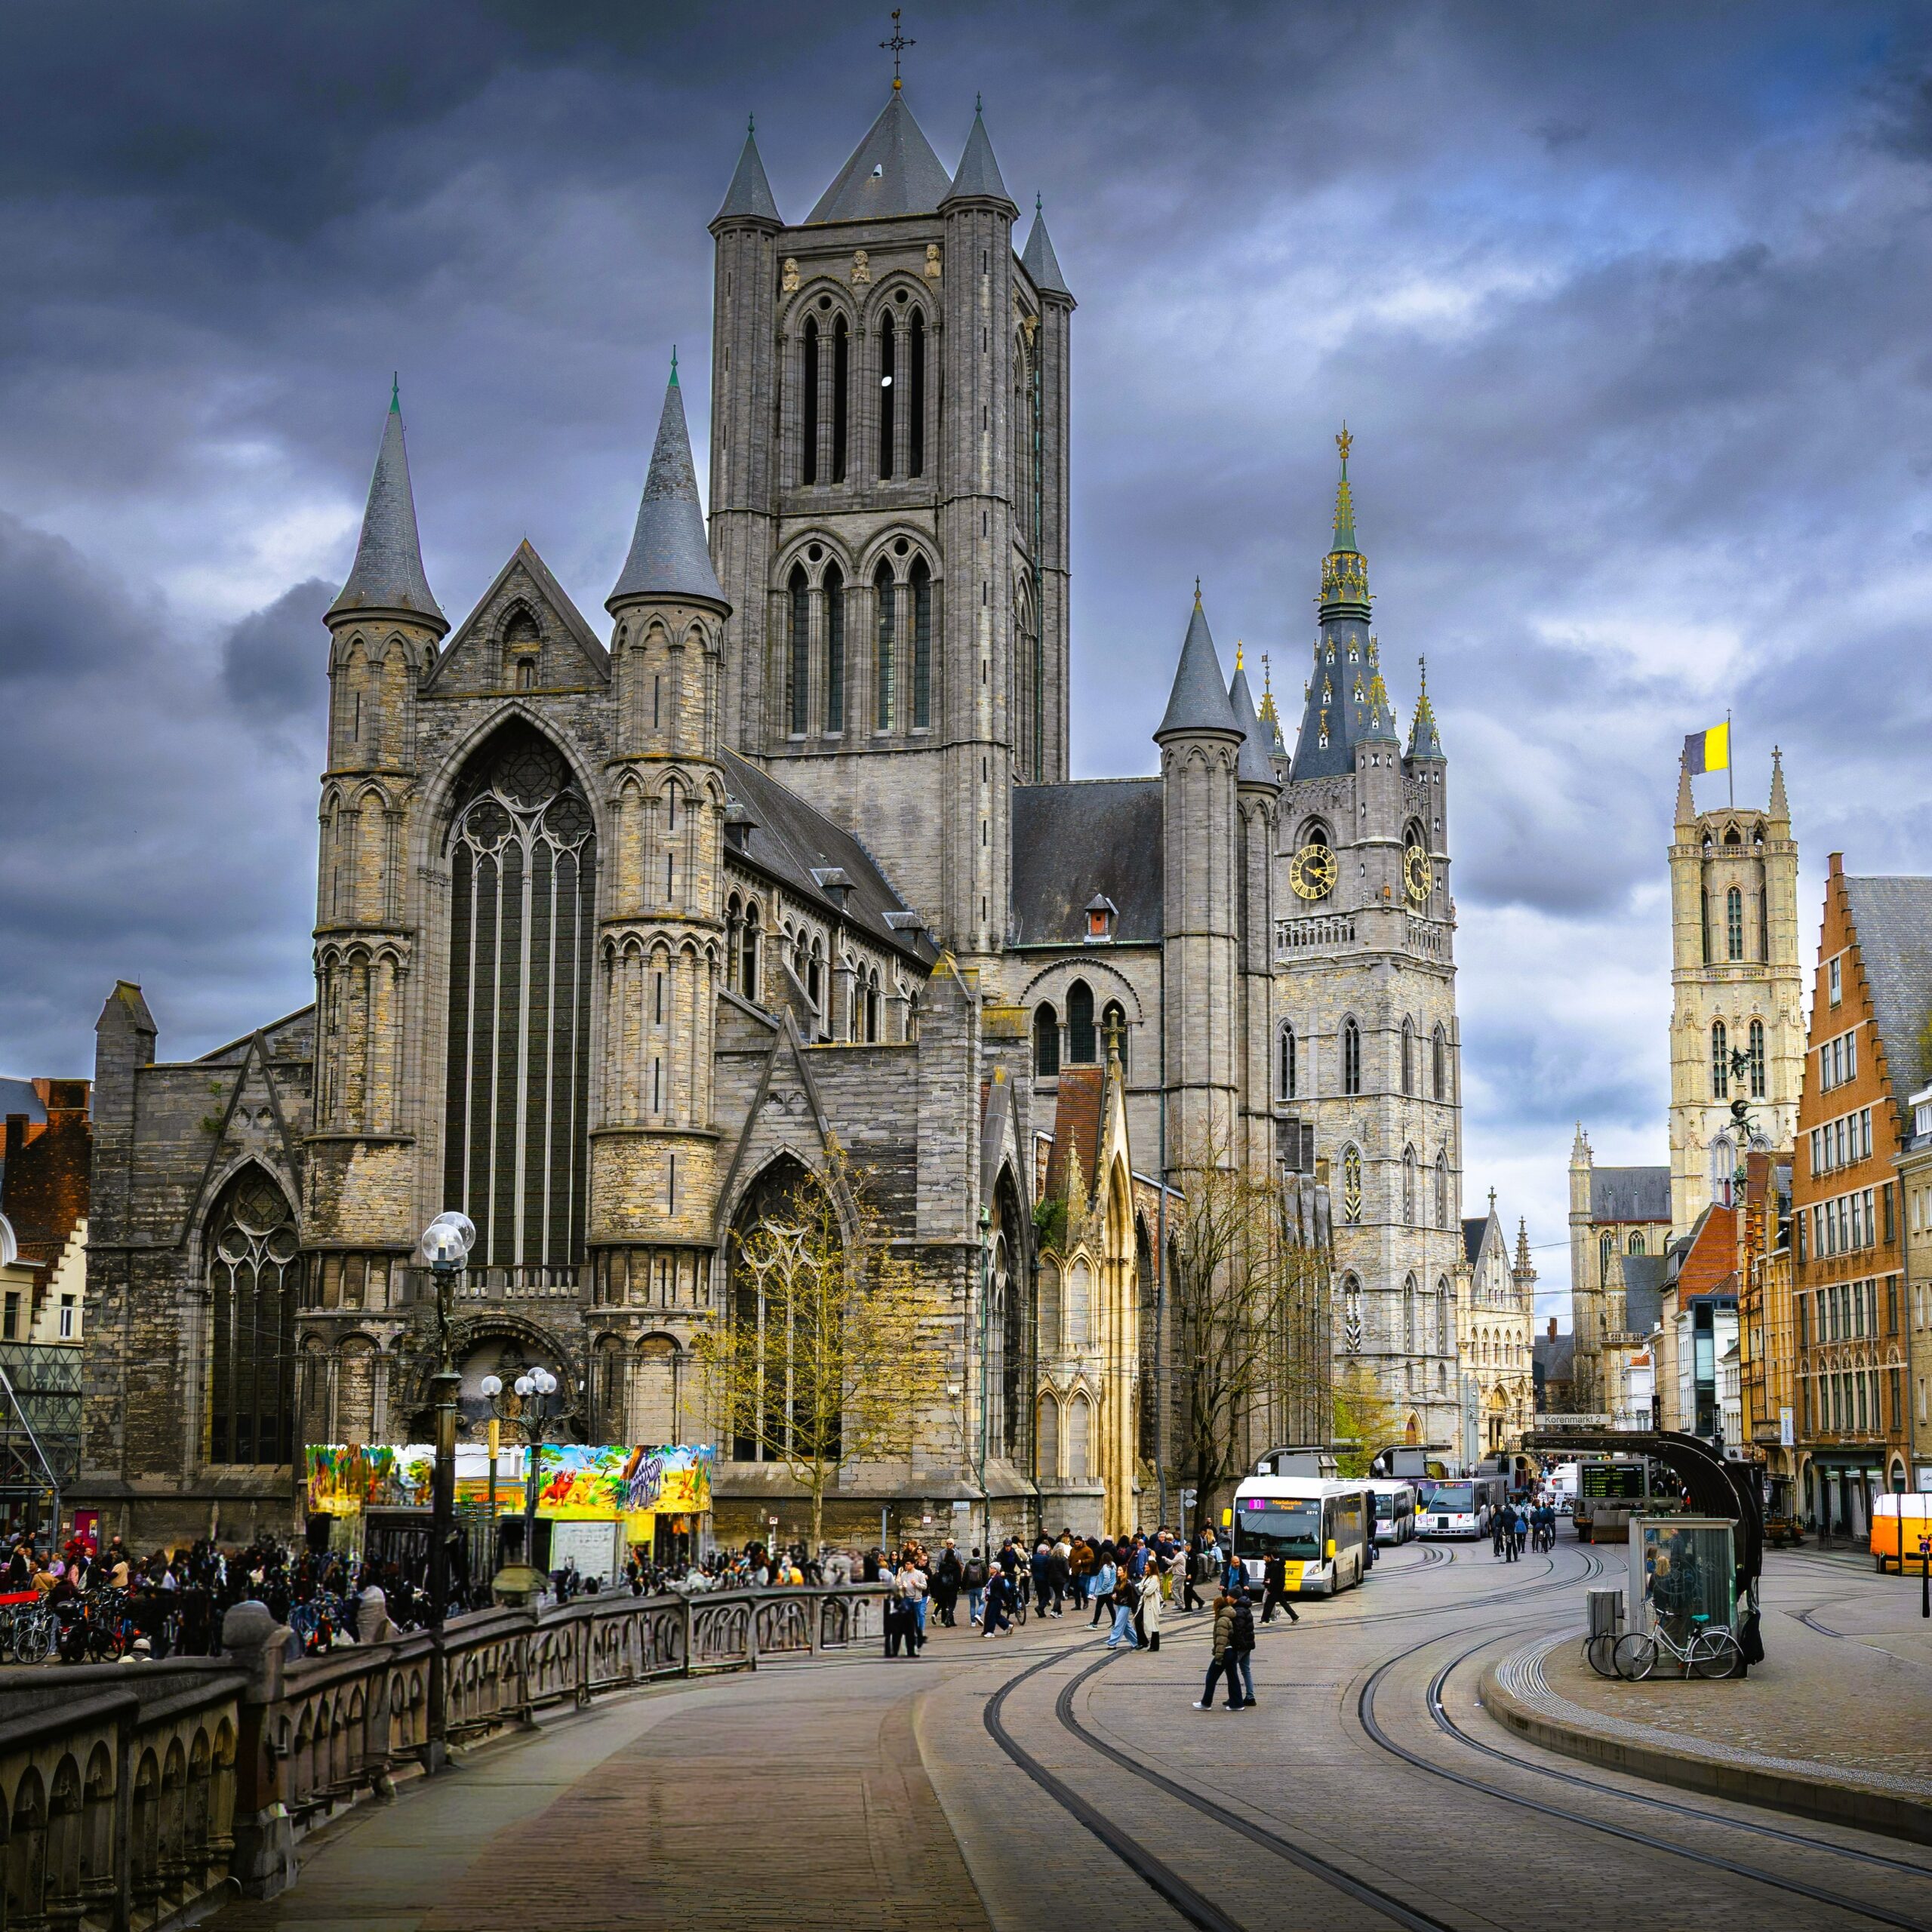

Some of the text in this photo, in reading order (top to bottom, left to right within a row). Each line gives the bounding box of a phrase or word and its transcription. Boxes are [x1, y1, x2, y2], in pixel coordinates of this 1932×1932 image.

[1545, 1415, 1601, 1423] Korenmarkt 2
[1254, 1499, 1261, 1509] 10
